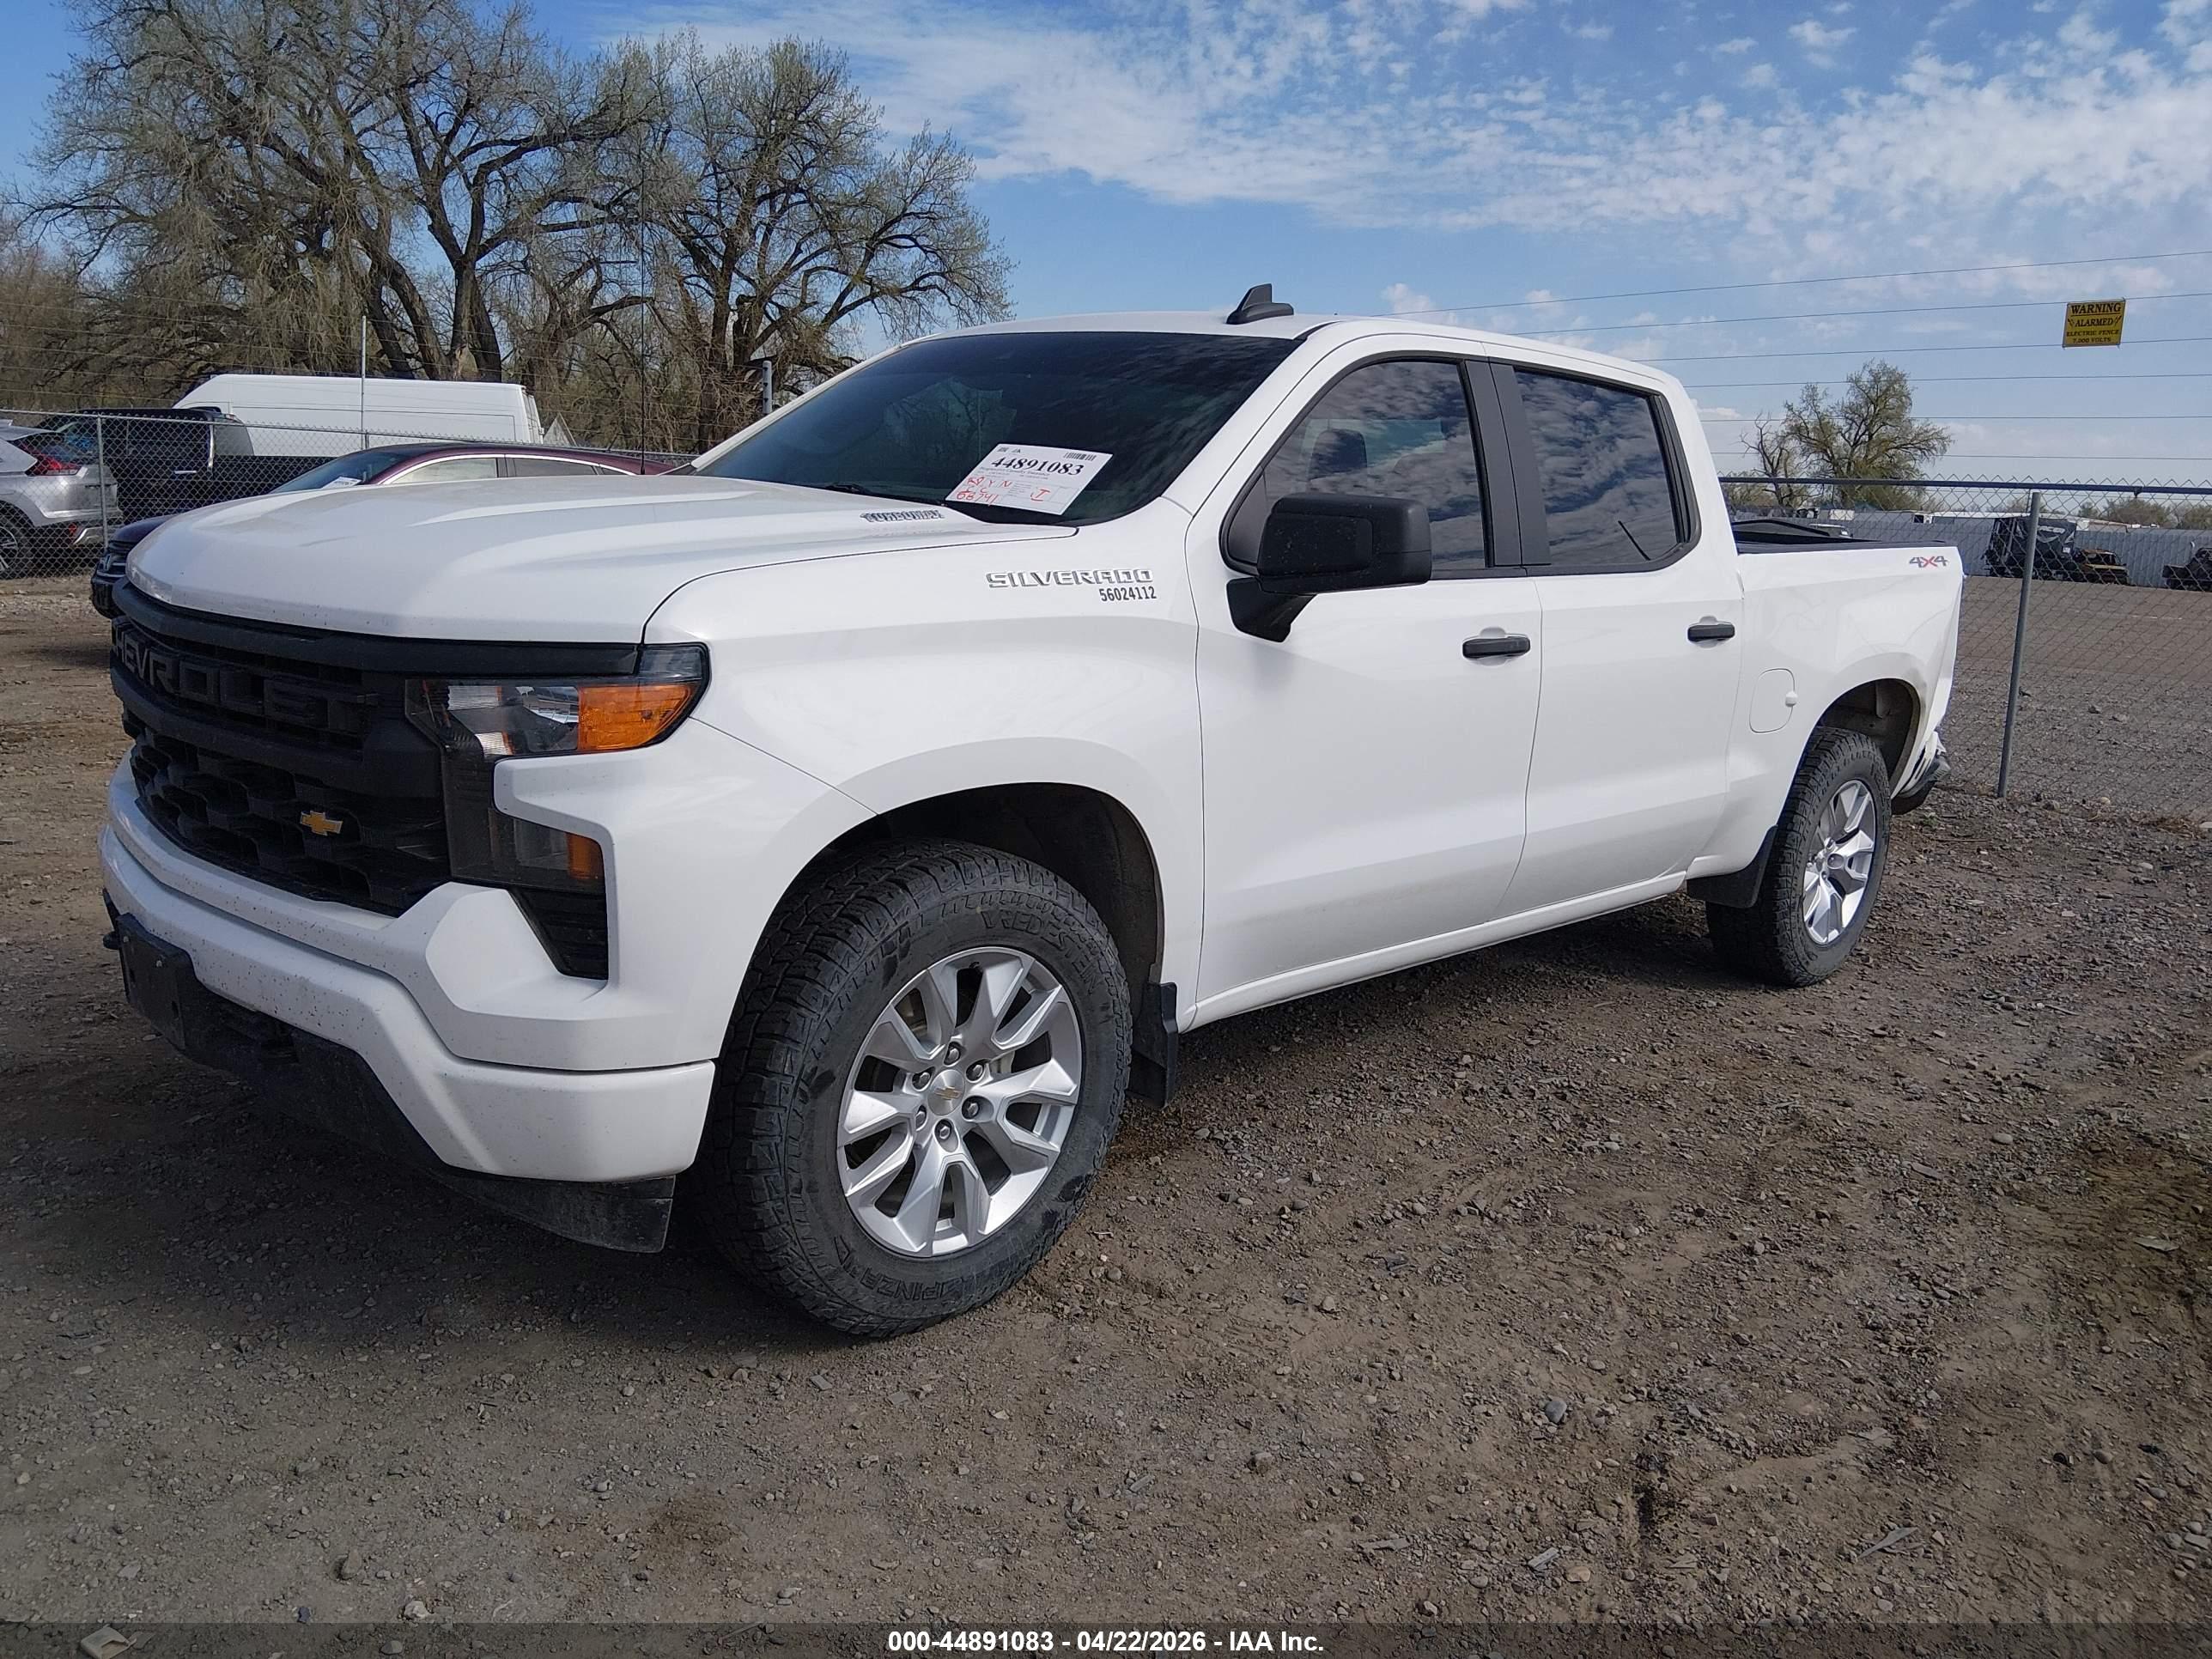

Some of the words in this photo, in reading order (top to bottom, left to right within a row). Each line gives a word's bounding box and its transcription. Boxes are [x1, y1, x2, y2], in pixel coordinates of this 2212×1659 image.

[2071, 302, 2122, 314] WARNING
[2075, 318, 2114, 327] ALARMED
[991, 457, 1085, 476] 44891083
[986, 568, 1153, 588] SILVERADO
[1098, 586, 1157, 602] 56024112
